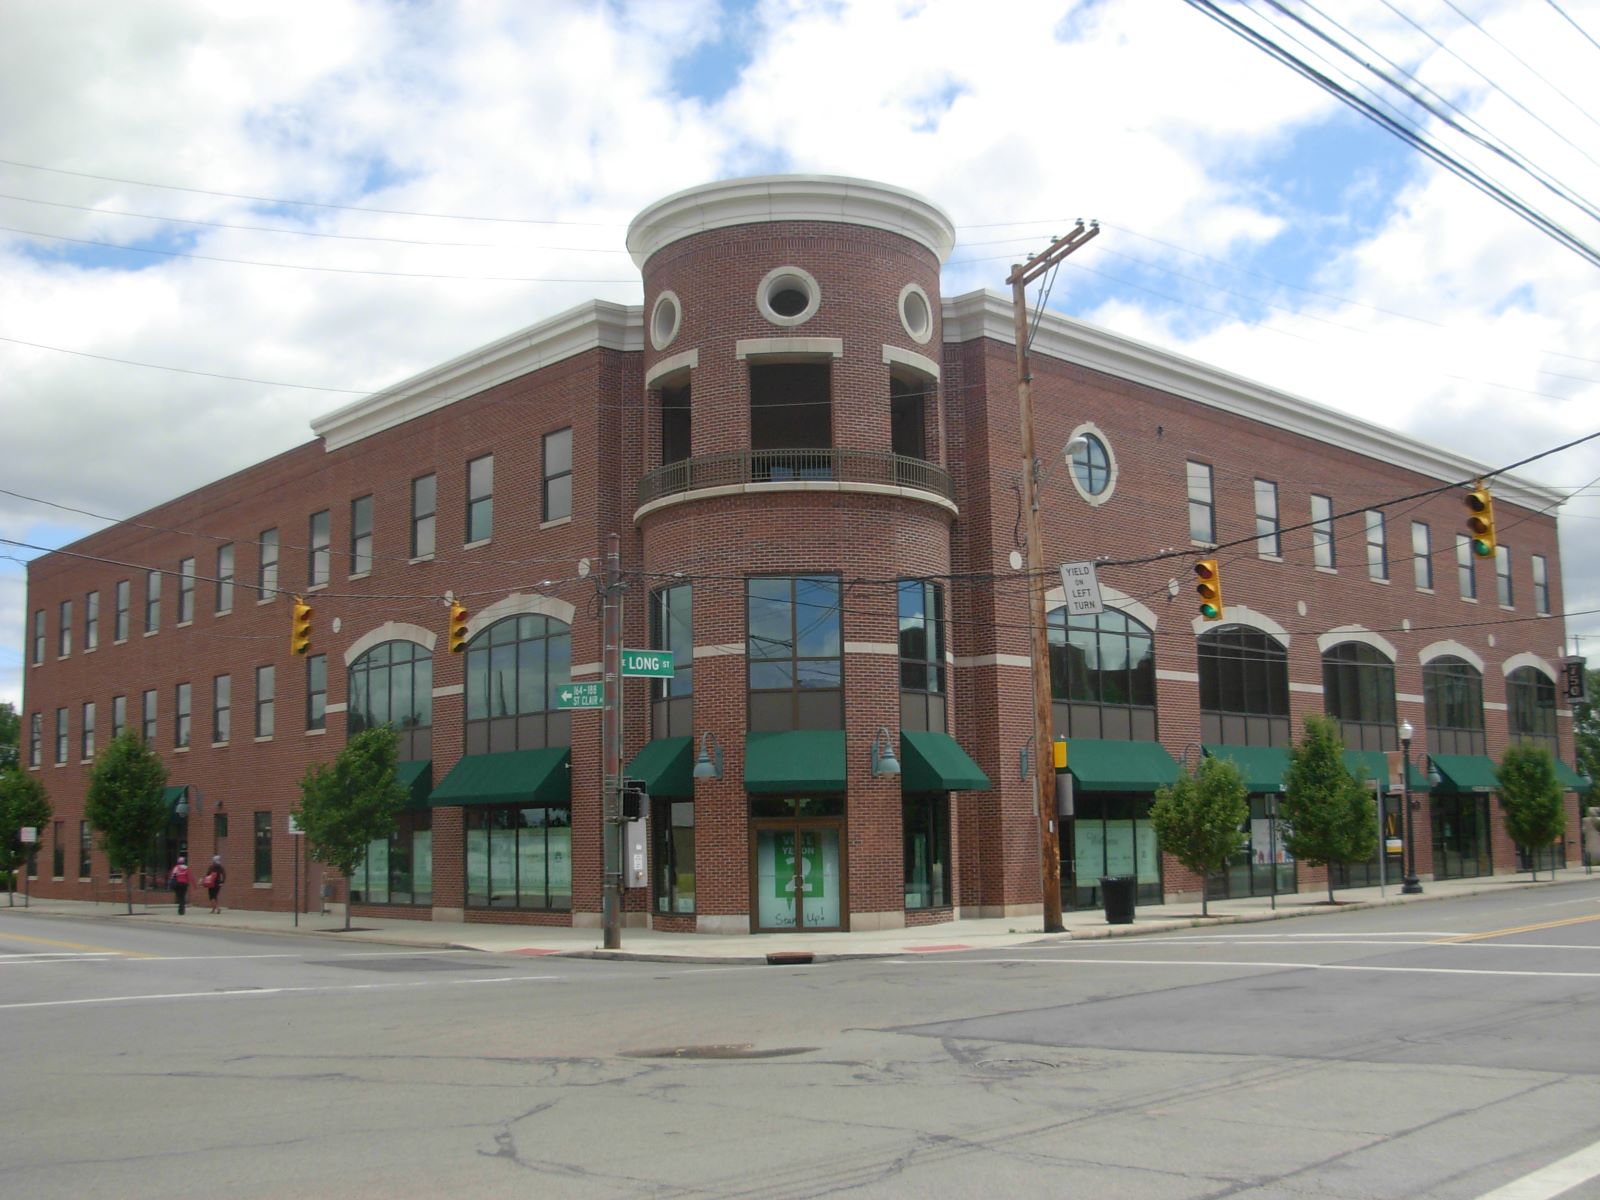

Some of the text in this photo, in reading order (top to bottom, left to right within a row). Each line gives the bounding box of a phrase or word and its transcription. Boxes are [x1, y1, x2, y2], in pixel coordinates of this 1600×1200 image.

[1066, 566, 1090, 576] YIELD
[1072, 589, 1091, 598] LEFT
[1074, 601, 1096, 610] TURN
[629, 657, 660, 671] LONG
[573, 696, 581, 706] ST
[582, 695, 598, 706] CLAIR
[784, 857, 813, 892] 2
